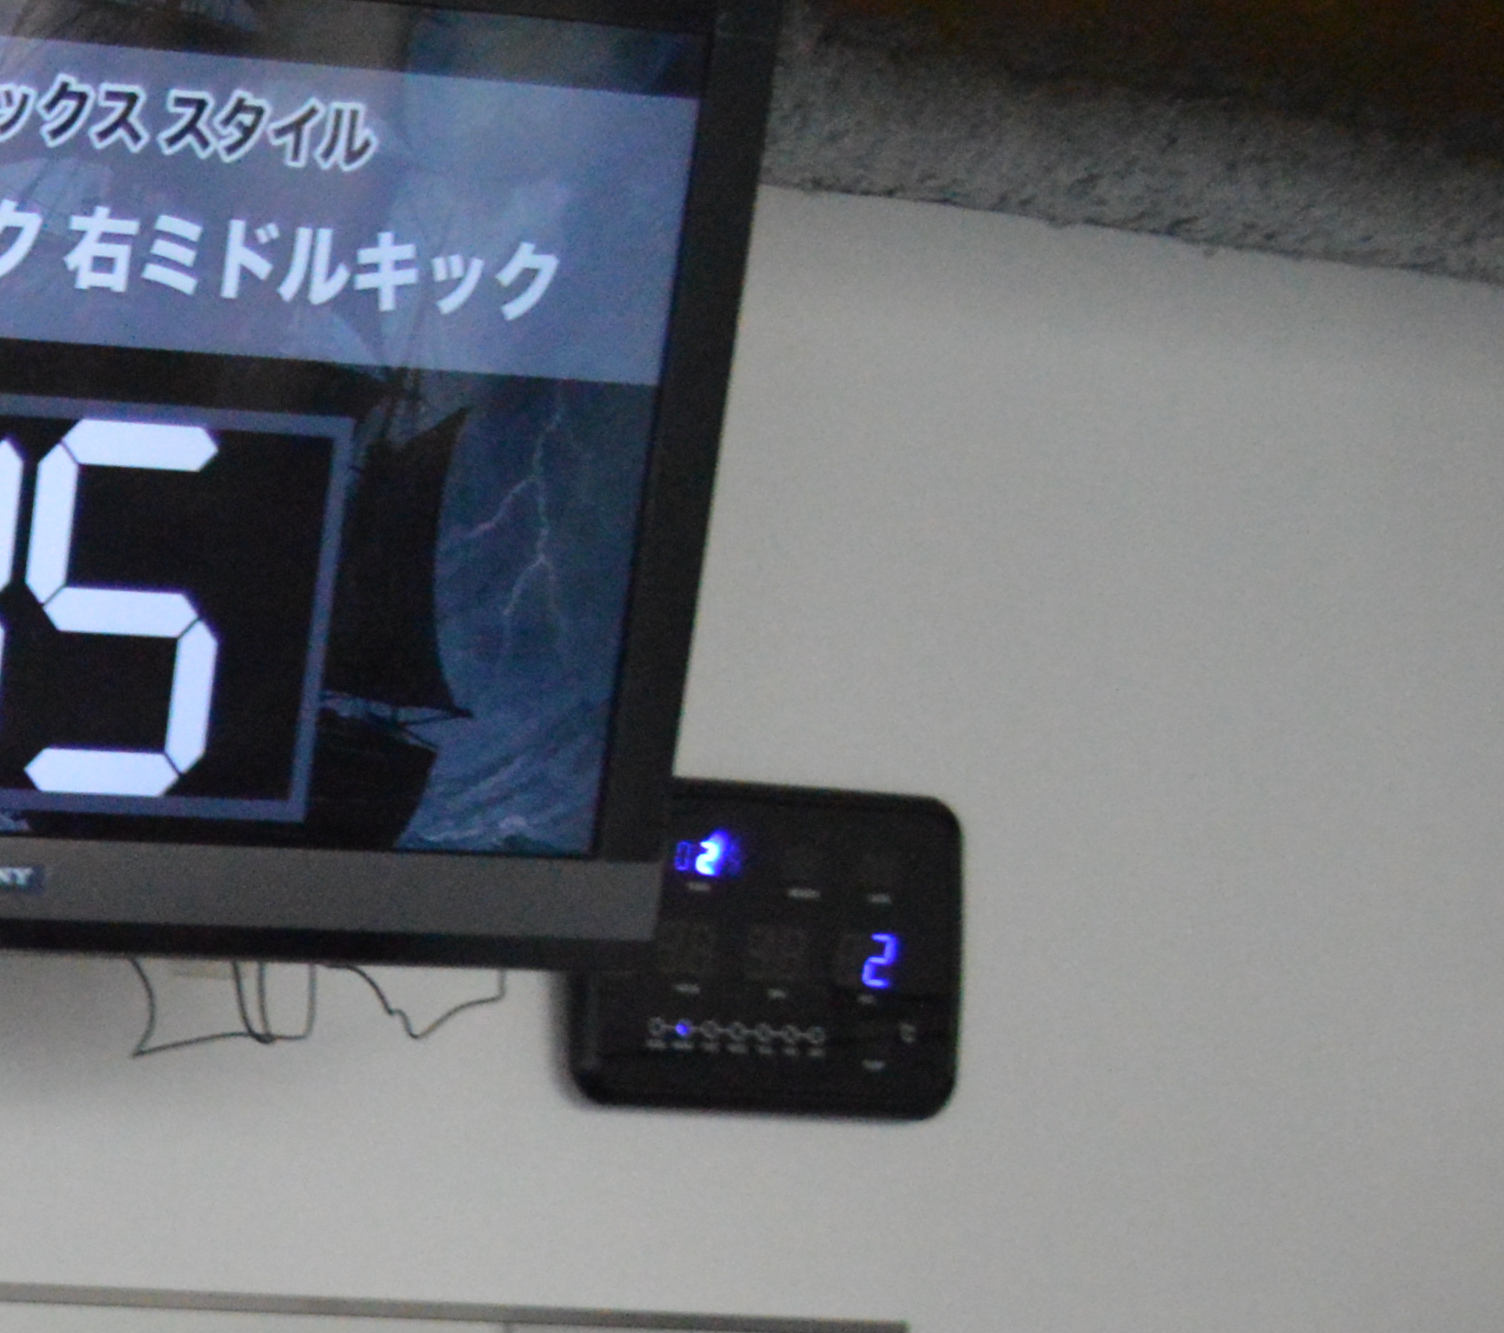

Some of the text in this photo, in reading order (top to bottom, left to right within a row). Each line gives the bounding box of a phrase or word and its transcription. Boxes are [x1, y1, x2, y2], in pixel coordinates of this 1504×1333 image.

[156, 87, 379, 172] スタイル
[64, 205, 559, 322] 右ミドルキック
[861, 932, 902, 989] 2
